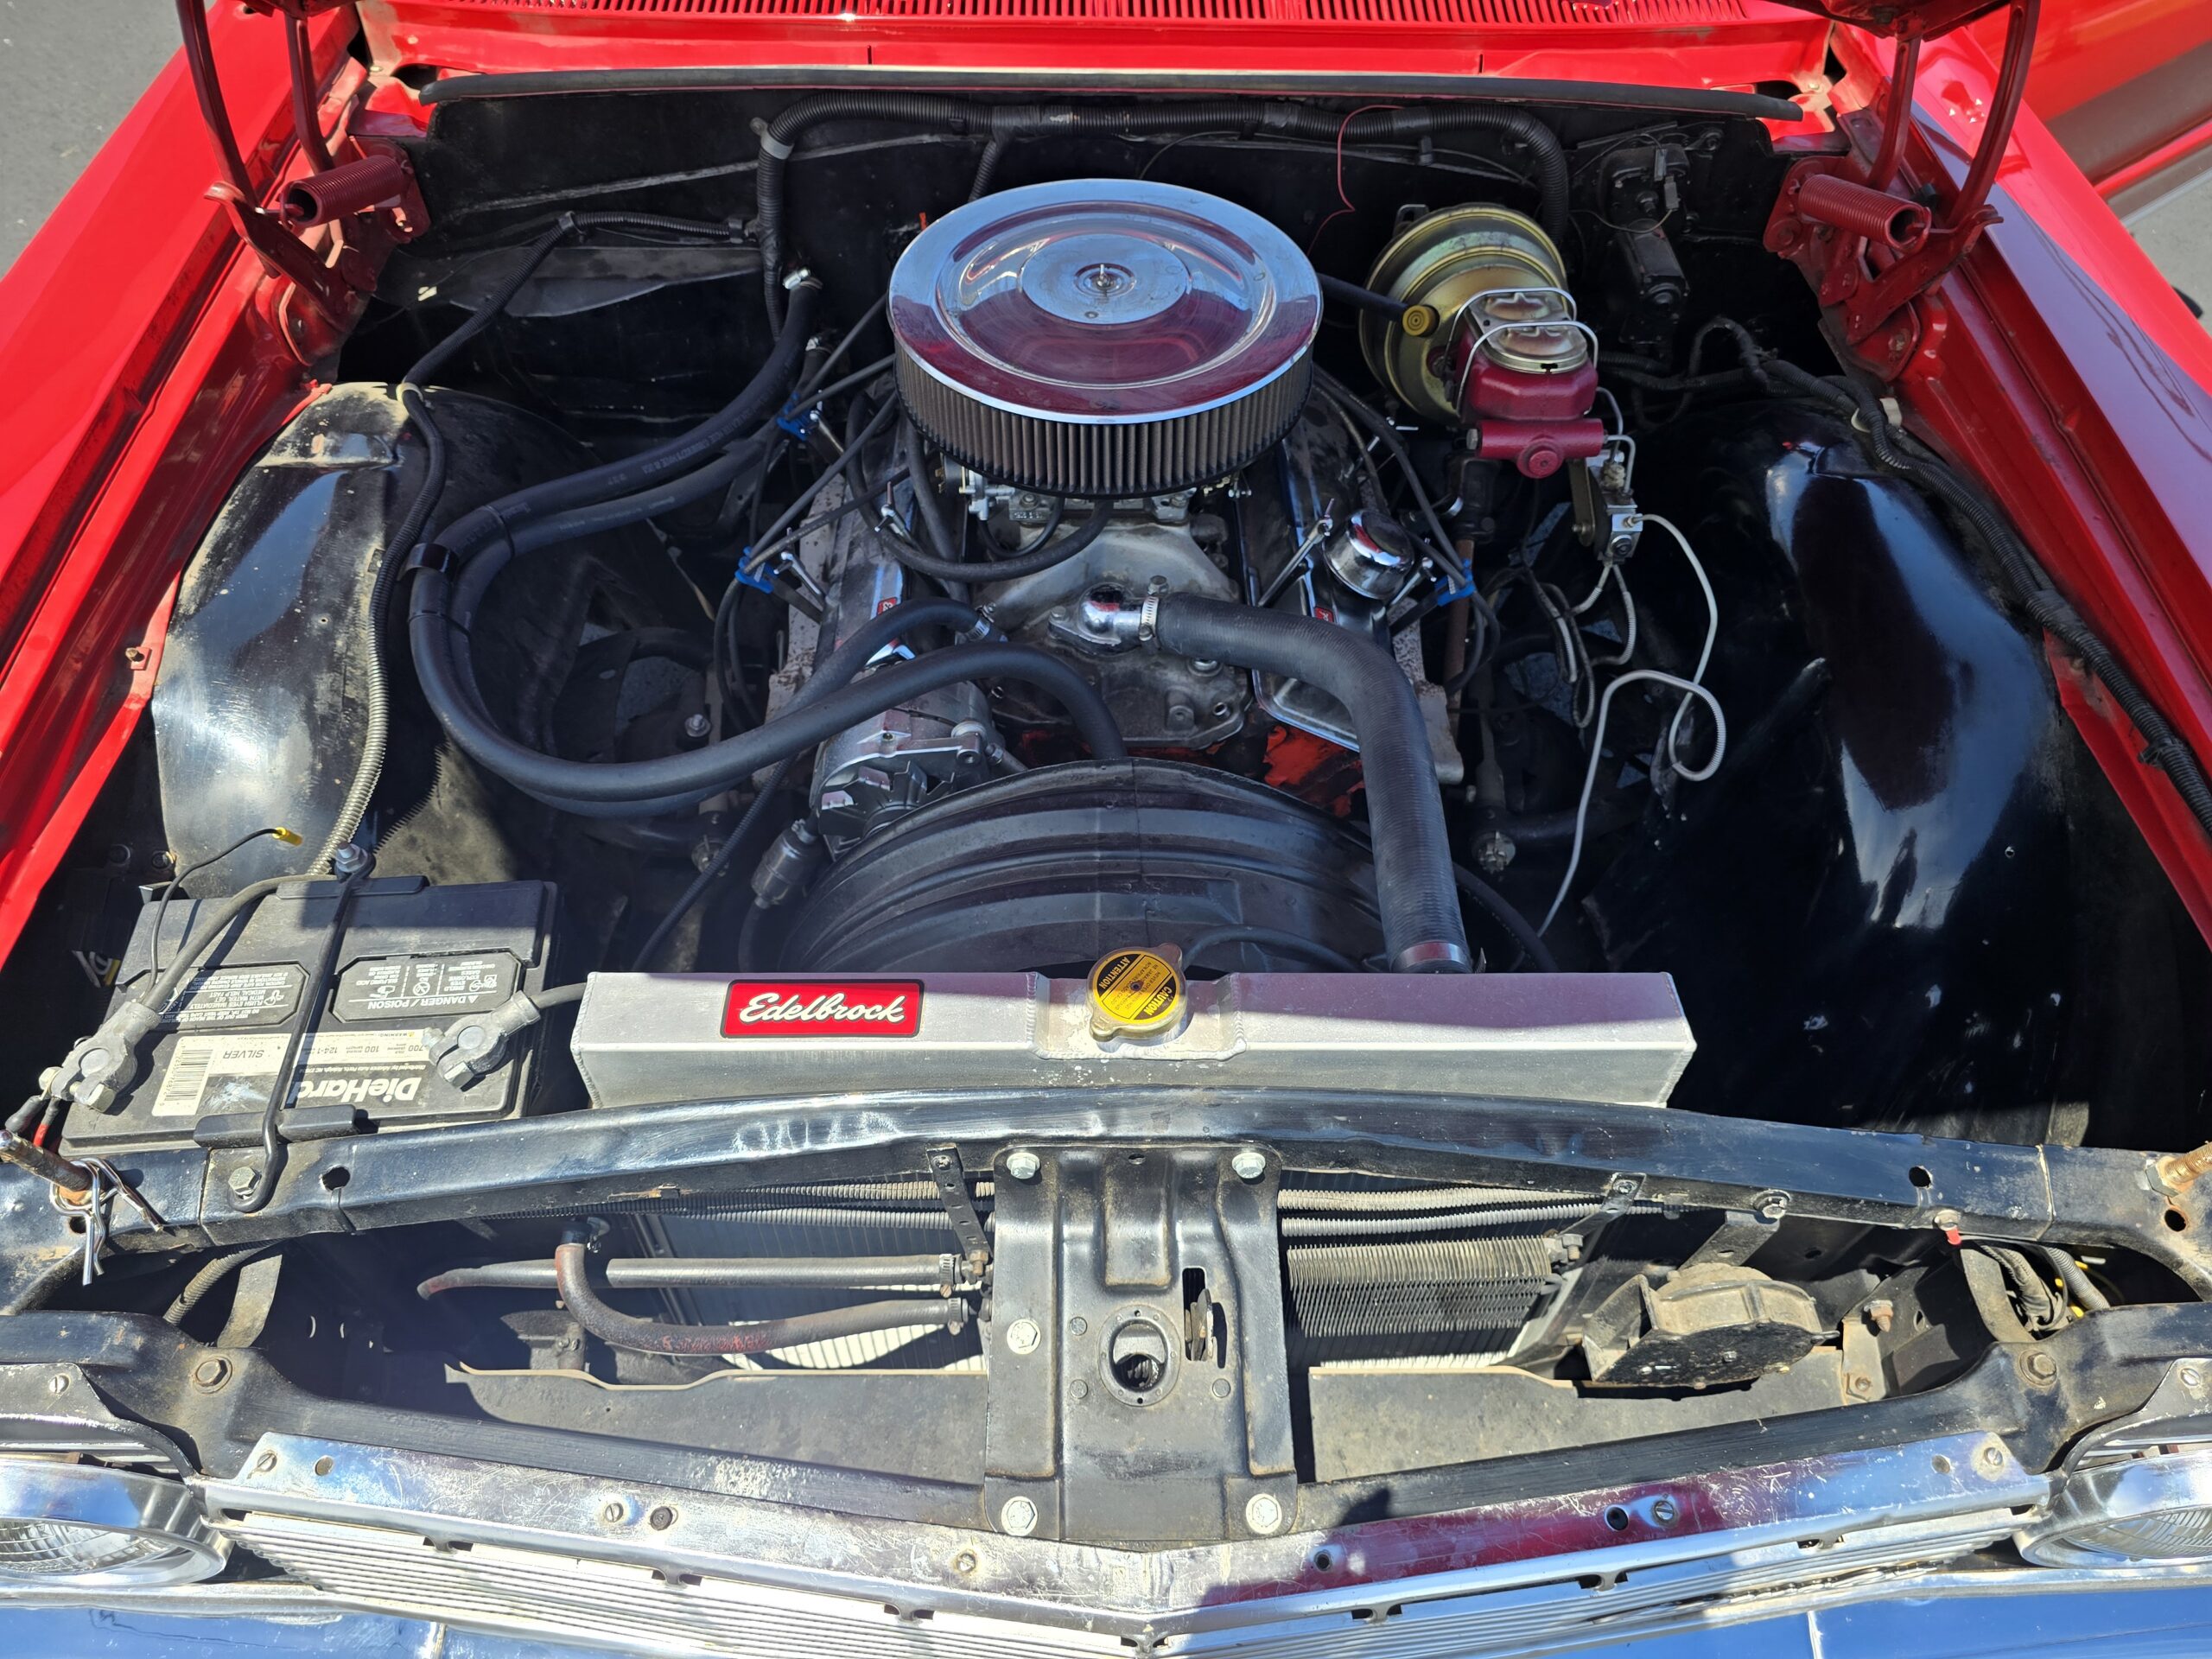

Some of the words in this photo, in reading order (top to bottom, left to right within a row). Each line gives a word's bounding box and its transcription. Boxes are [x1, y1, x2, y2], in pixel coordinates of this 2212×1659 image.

[1099, 957, 1130, 989] ATTENTION
[368, 1000, 410, 1009] POISON
[422, 995, 467, 1006] DANGER
[740, 993, 906, 1023] Edelbrock
[1144, 986, 1173, 1016] CAUTION
[223, 1050, 264, 1059] SILVER
